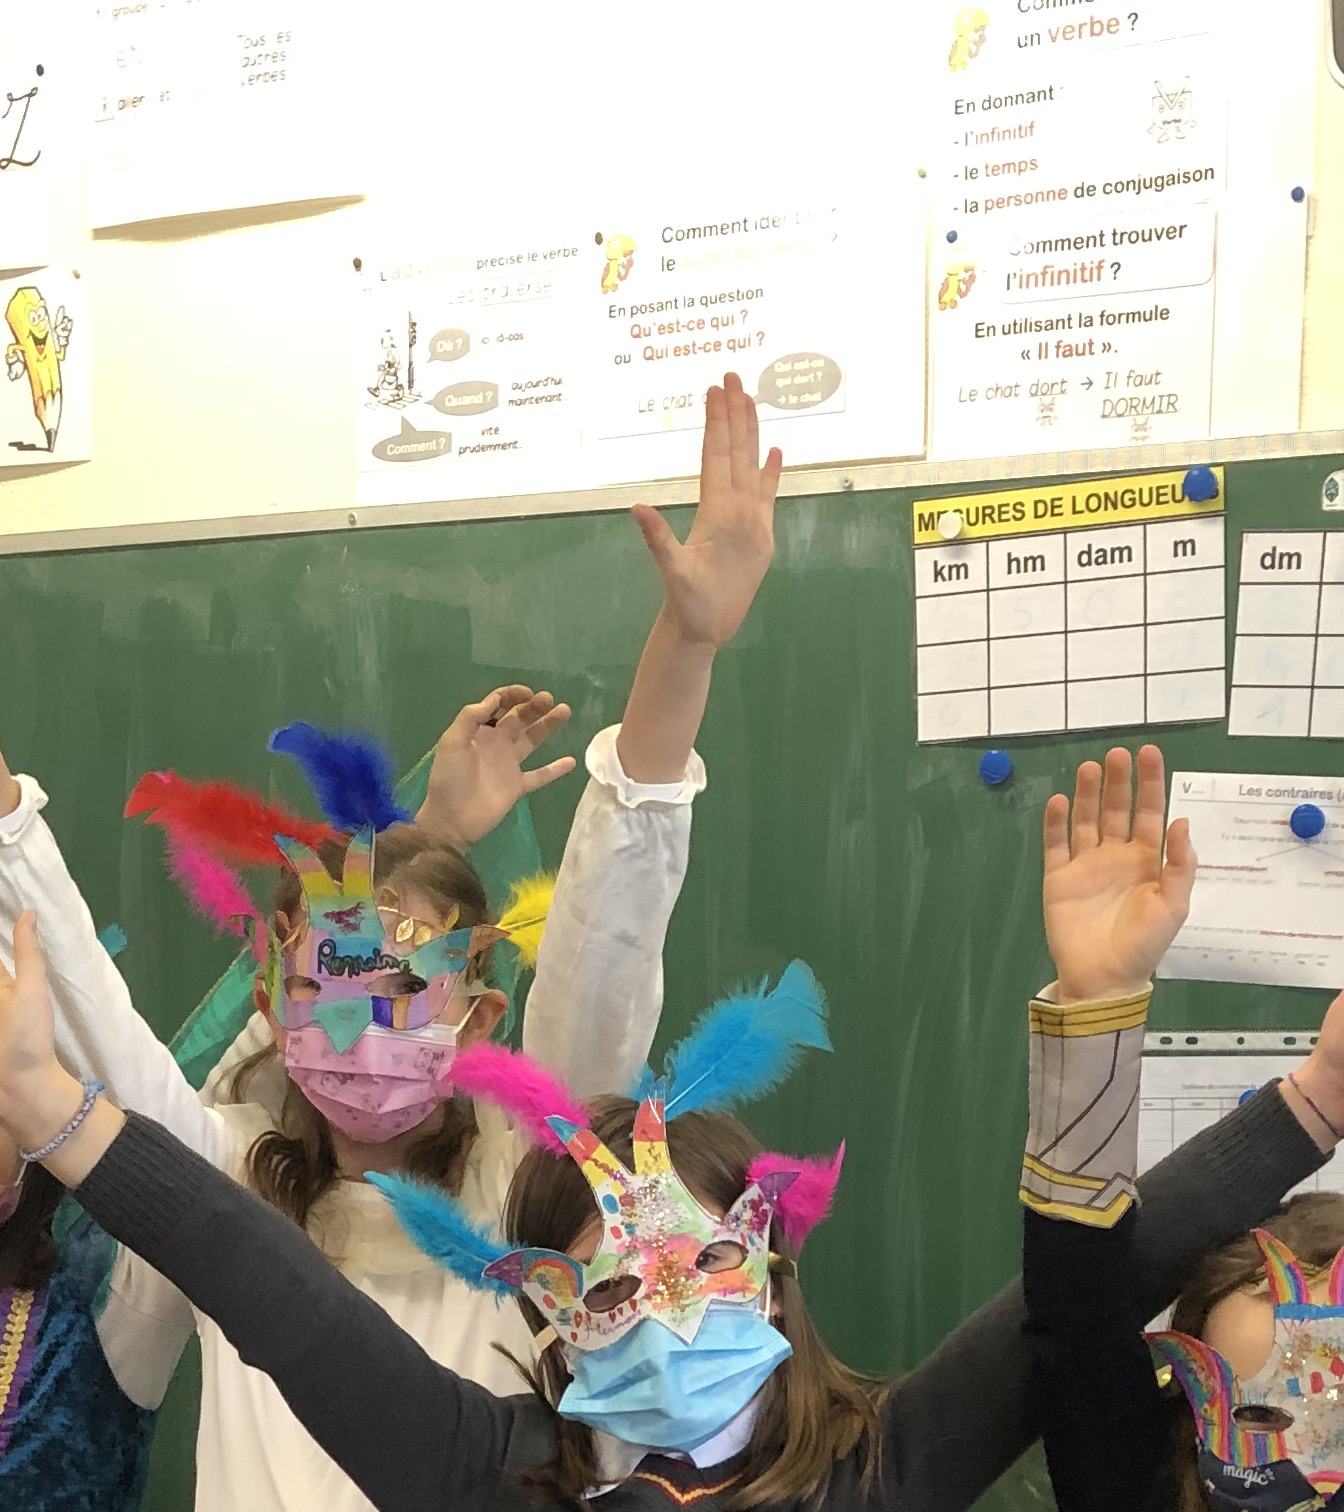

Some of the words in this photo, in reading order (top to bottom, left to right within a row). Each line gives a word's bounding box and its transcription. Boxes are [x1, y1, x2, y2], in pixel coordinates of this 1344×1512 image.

[1017, 31, 1041, 49] un
[1048, 15, 1121, 43] verbe
[954, 98, 976, 116] En
[982, 86, 1055, 112] donnant
[964, 166, 979, 181] le
[984, 156, 1039, 180] temps
[964, 199, 979, 214] la
[984, 186, 1068, 215] personne
[1074, 182, 1097, 199] de
[1102, 166, 1215, 200] conjugaison
[662, 217, 748, 244] Comment
[1111, 222, 1188, 246] trouver
[662, 256, 676, 272] le
[609, 305, 626, 319] En
[631, 299, 678, 319] posant
[683, 295, 695, 308] la
[700, 288, 764, 308] question
[710, 312, 735, 329] qui
[974, 321, 997, 339] En
[1002, 312, 1074, 336] utilisant
[1079, 310, 1095, 329] la
[1099, 304, 1171, 328] formule
[614, 353, 631, 365] ou
[642, 343, 669, 361] Qui
[673, 338, 722, 357] est-ce
[726, 335, 751, 353] qui
[1054, 338, 1095, 359] faut
[958, 385, 978, 404] Le
[985, 381, 1021, 401] chat
[1029, 376, 1068, 398] dort
[1125, 368, 1162, 388] faut
[1101, 393, 1179, 418] DORMIR
[1034, 495, 1064, 519] DE
[1072, 483, 1219, 516] LONGUEU
[933, 558, 969, 583] km
[1006, 550, 1046, 576] hm
[1076, 542, 1133, 569] dam
[1173, 536, 1197, 558] m
[1260, 546, 1302, 572] dm
[1238, 784, 1262, 799] Les
[1266, 786, 1334, 801] contraires
[1223, 1463, 1268, 1486] magic
